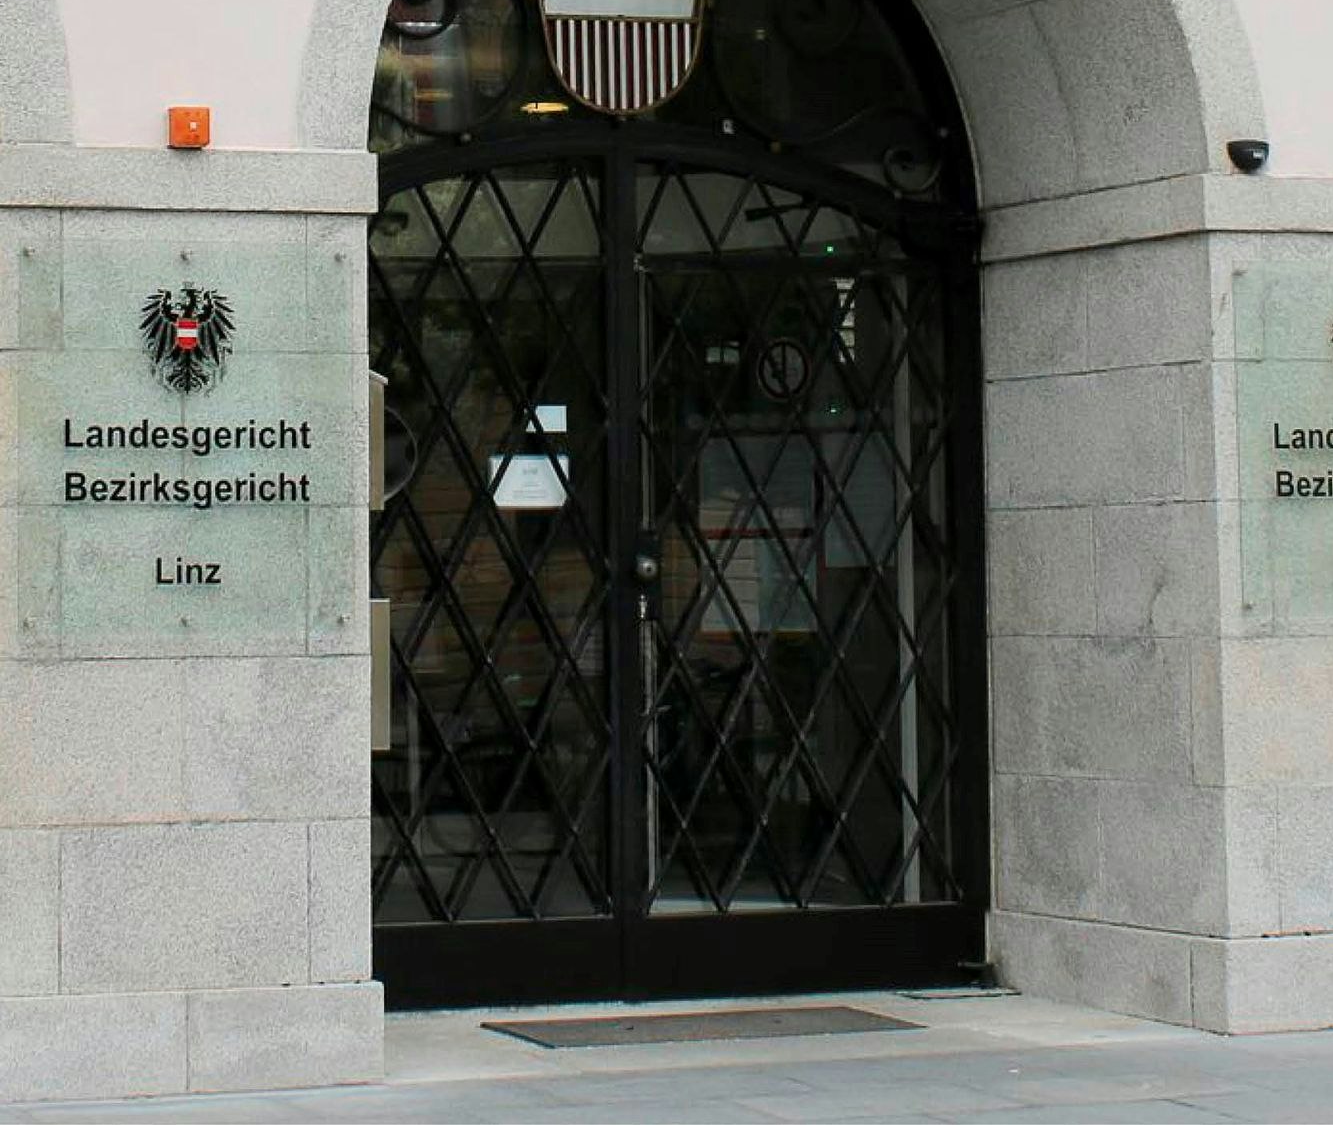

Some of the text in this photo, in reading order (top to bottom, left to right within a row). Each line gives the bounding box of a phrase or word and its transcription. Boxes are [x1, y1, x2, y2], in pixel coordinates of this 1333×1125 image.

[64, 418, 312, 454] Landesgericht
[64, 472, 311, 508] Bezirksgericht
[155, 557, 223, 586] Linz
